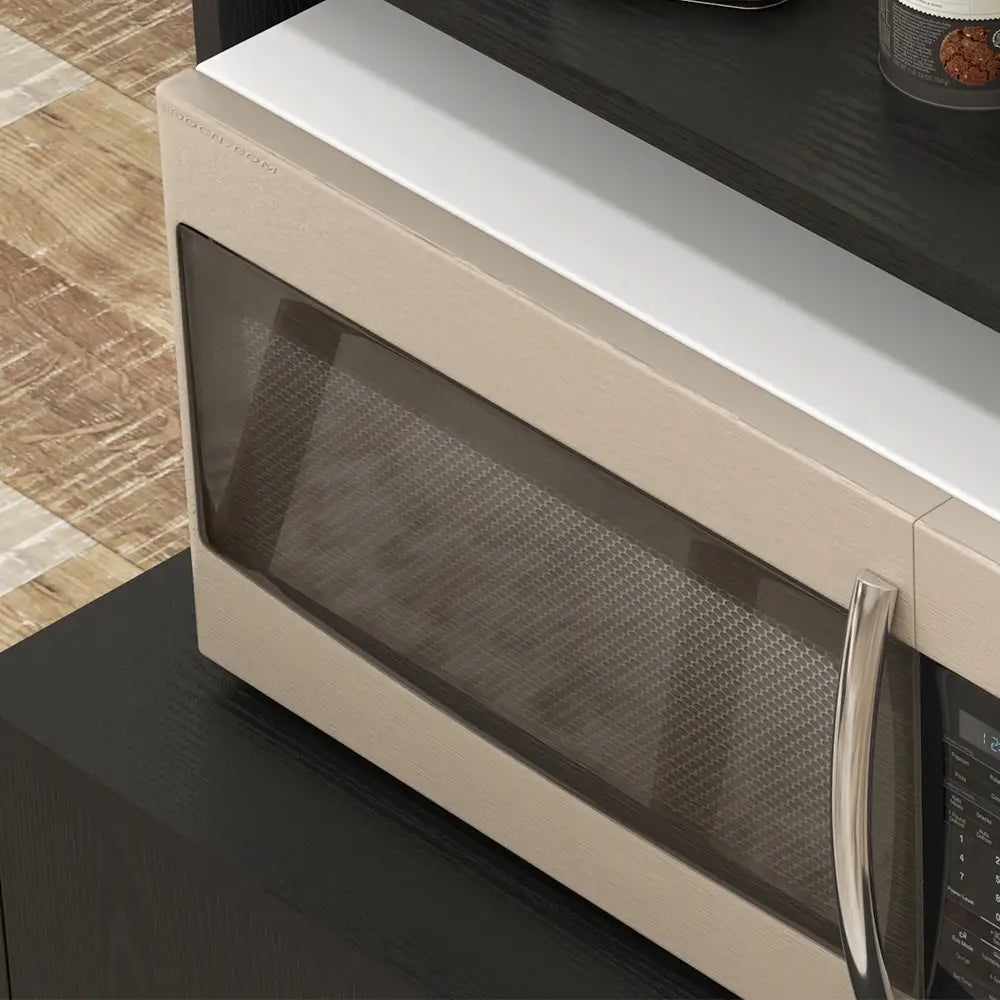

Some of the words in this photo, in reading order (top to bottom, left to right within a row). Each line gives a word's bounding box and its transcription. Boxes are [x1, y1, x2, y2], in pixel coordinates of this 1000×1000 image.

[960, 854, 964, 862] 4
[995, 856, 1000, 865] 2
[960, 872, 964, 880] 7
[995, 875, 1000, 884] 5
[995, 894, 1000, 903] 8
[995, 913, 1000, 922] 0
